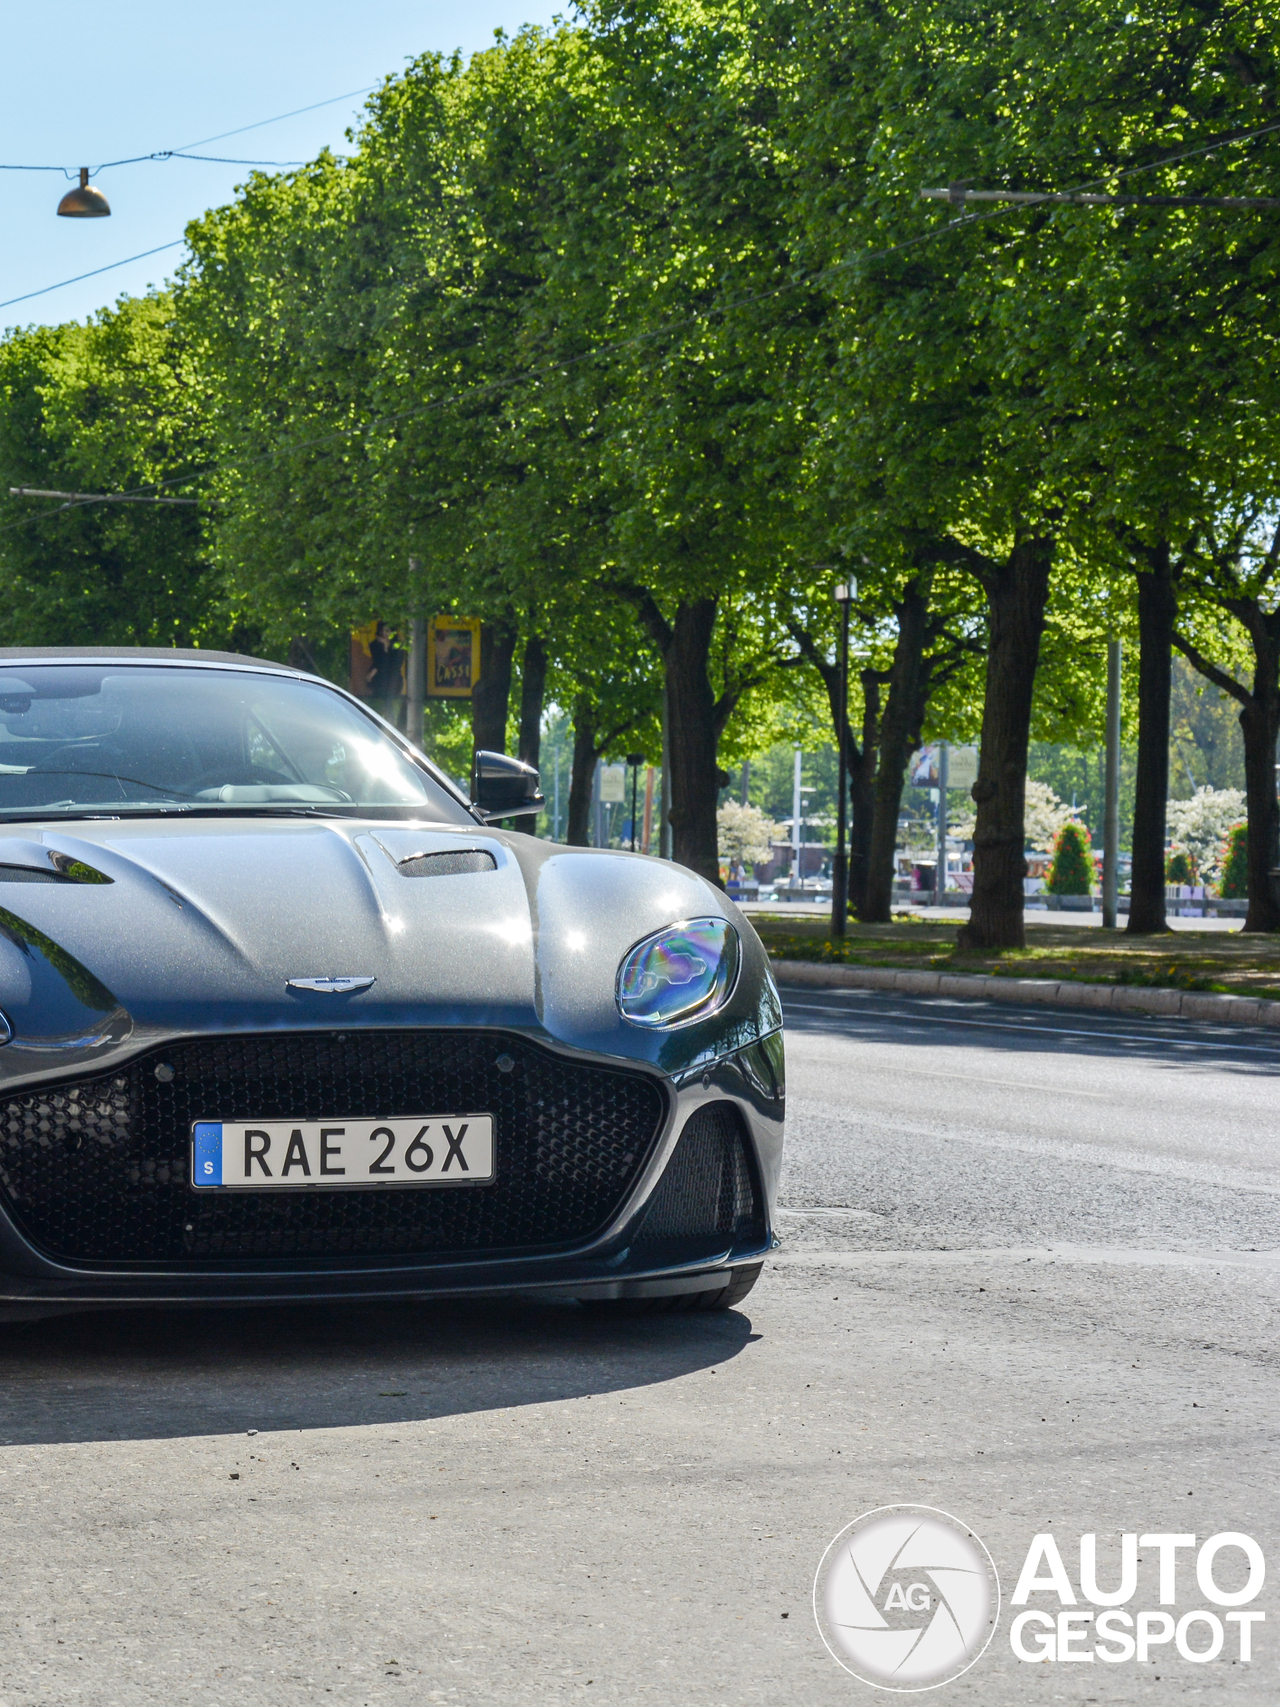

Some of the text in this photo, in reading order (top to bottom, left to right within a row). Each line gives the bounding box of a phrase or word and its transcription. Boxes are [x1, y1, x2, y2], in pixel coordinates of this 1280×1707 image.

[244, 1124, 470, 1177] RAE 26X
[204, 1161, 214, 1174] S
